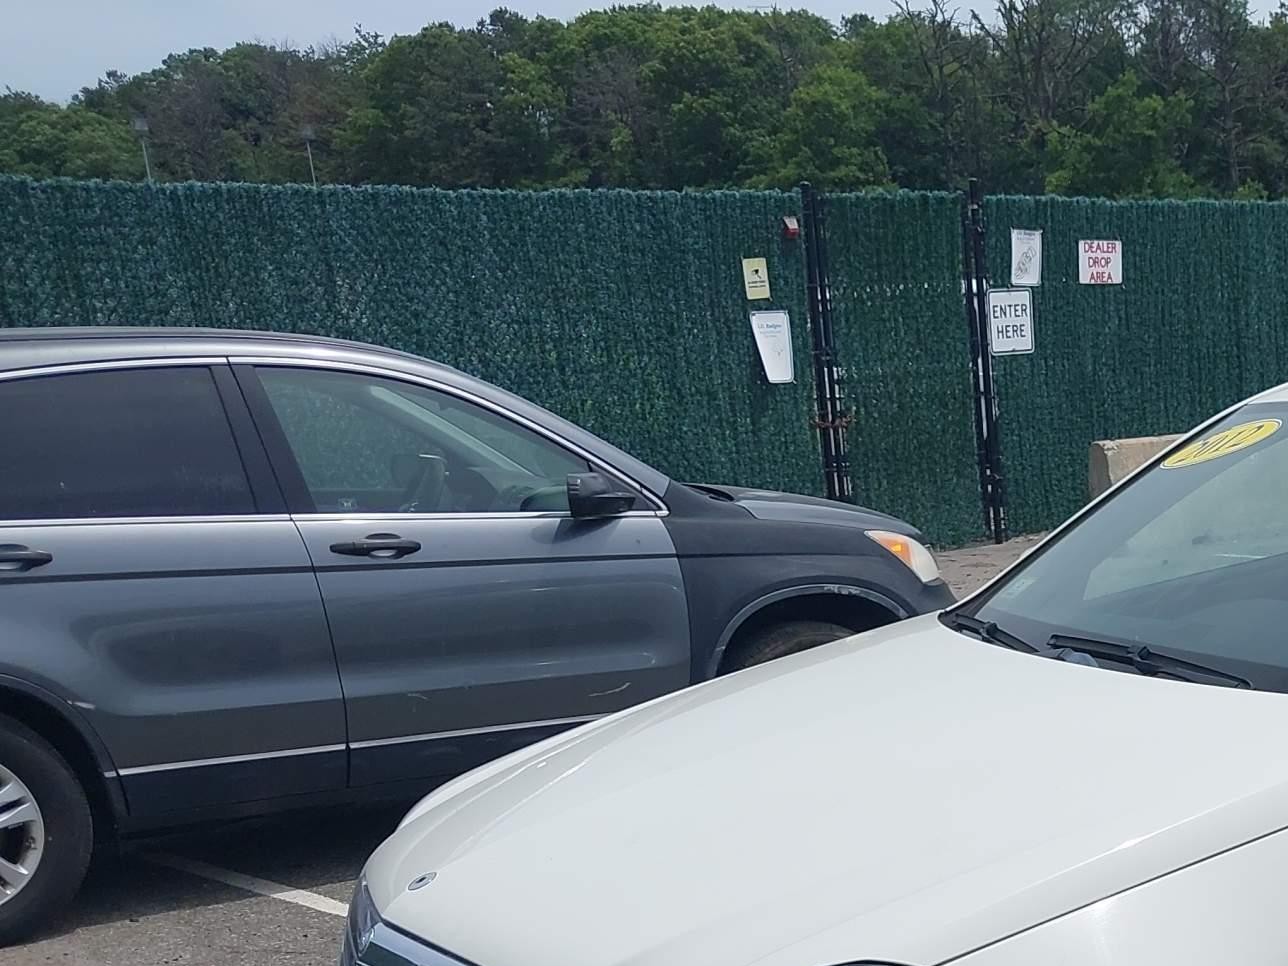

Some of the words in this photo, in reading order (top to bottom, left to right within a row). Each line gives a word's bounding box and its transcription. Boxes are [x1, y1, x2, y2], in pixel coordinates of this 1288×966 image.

[1083, 242, 1117, 253] DEALER
[1088, 257, 1112, 268] DROP
[1089, 271, 1113, 283] AREA
[992, 303, 1028, 319] ENTER
[996, 324, 1026, 340] HERE
[1172, 424, 1265, 464] 2012
